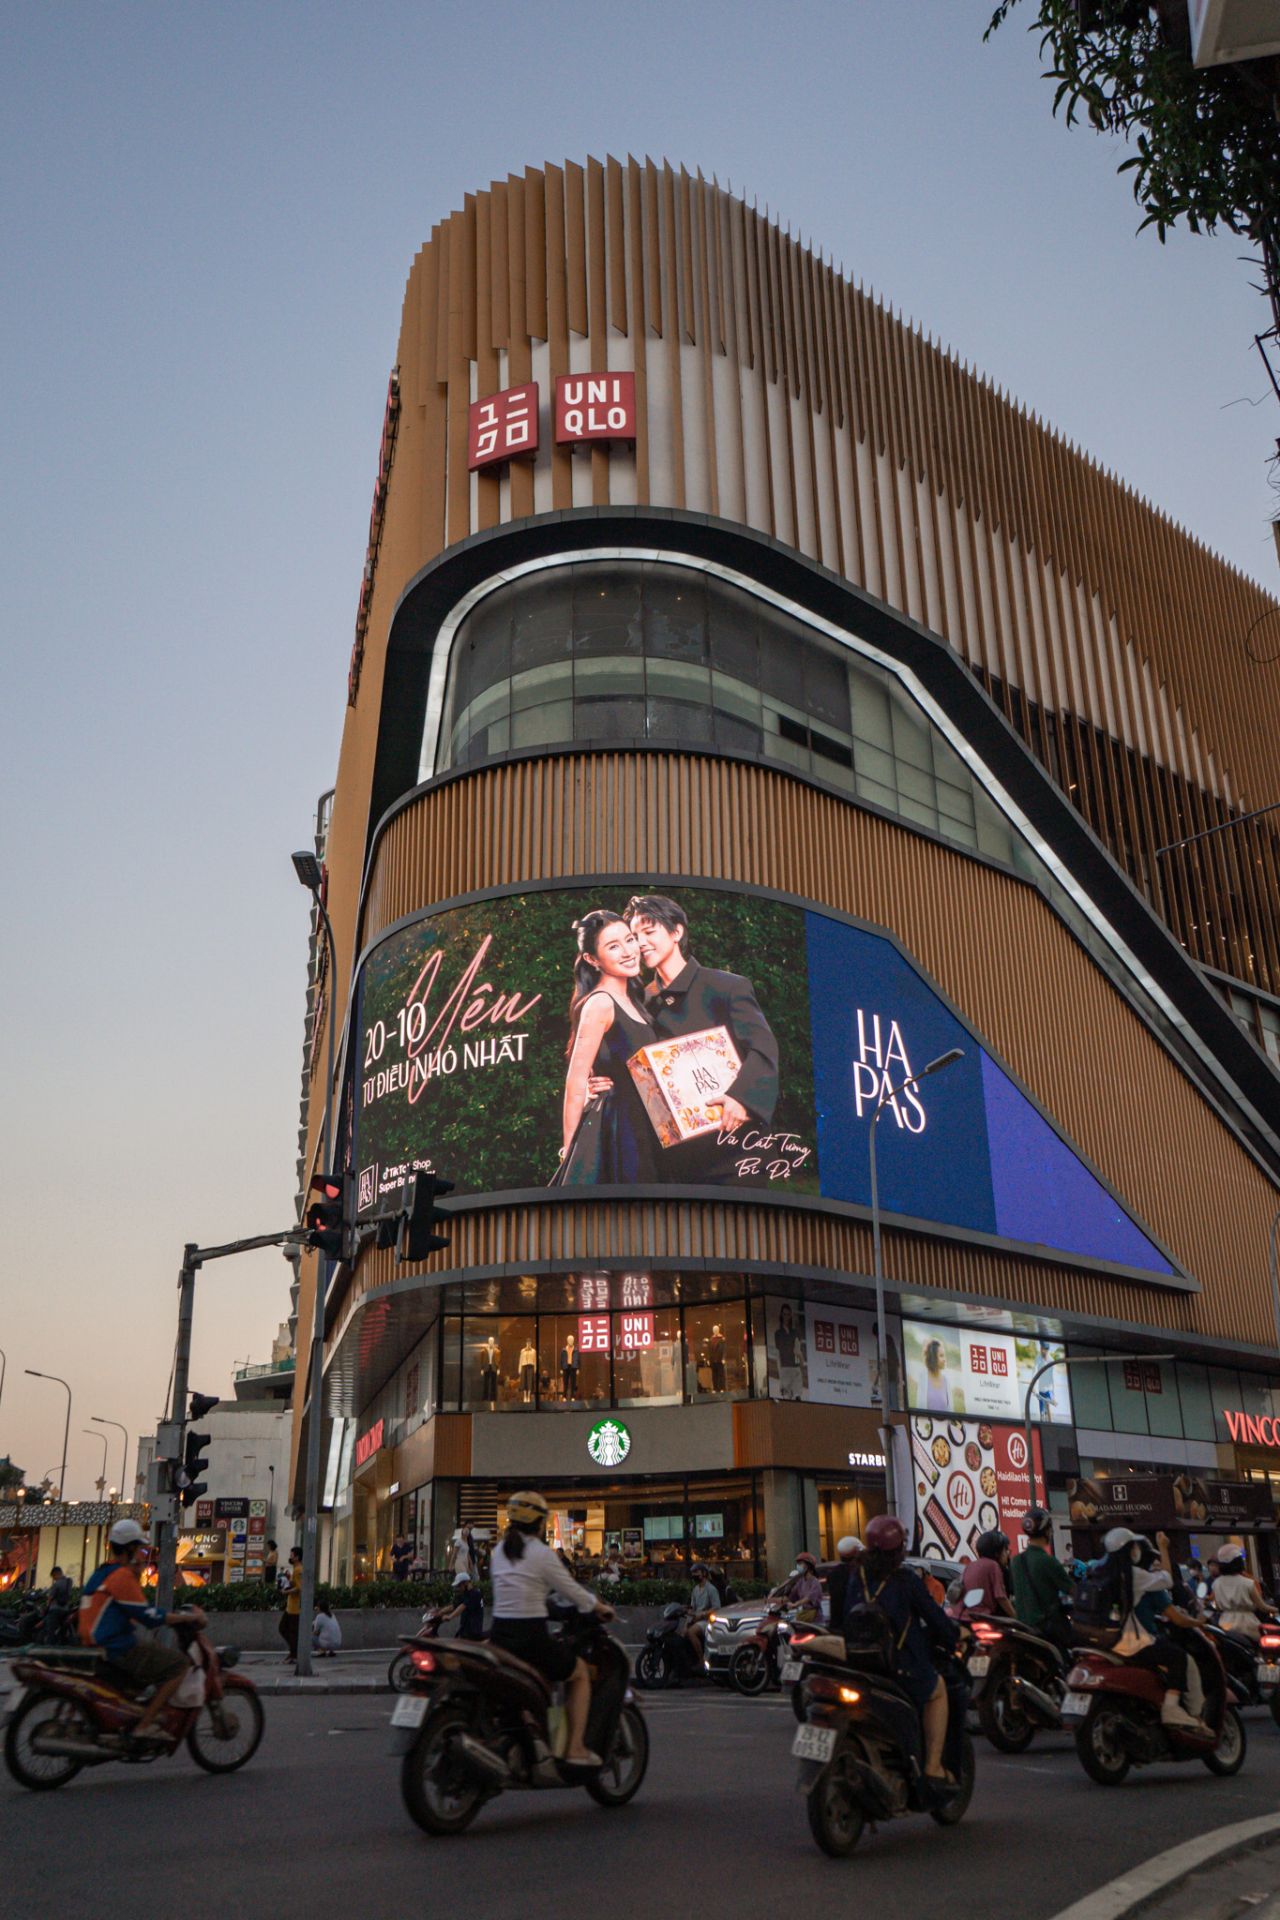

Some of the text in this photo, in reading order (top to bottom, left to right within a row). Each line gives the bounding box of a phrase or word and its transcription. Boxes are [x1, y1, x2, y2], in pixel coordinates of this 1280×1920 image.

[564, 379, 621, 405] UNI
[478, 392, 529, 430] ユニ
[564, 406, 627, 436] QLO
[475, 418, 529, 458] クロ
[407, 934, 542, 1105] Yên
[364, 1001, 427, 1069] 20-10
[856, 1008, 913, 1077] HA
[463, 1033, 530, 1071] NHẤT
[692, 1066, 715, 1083] HA
[695, 1078, 721, 1095] PAS
[852, 1061, 927, 1134] PAS
[389, 1158, 432, 1179] TikTo Shop
[378, 1175, 417, 1194] Super Brn
[582, 1319, 608, 1334] ユニ
[623, 1317, 649, 1331] UNI
[840, 1327, 856, 1340] UNI
[581, 1335, 609, 1349] クロ
[623, 1333, 651, 1349] QLO
[841, 1340, 857, 1353] QLO
[991, 1350, 1005, 1362] UNI
[993, 1362, 1007, 1375] QLO
[952, 1479, 970, 1509] Hi
